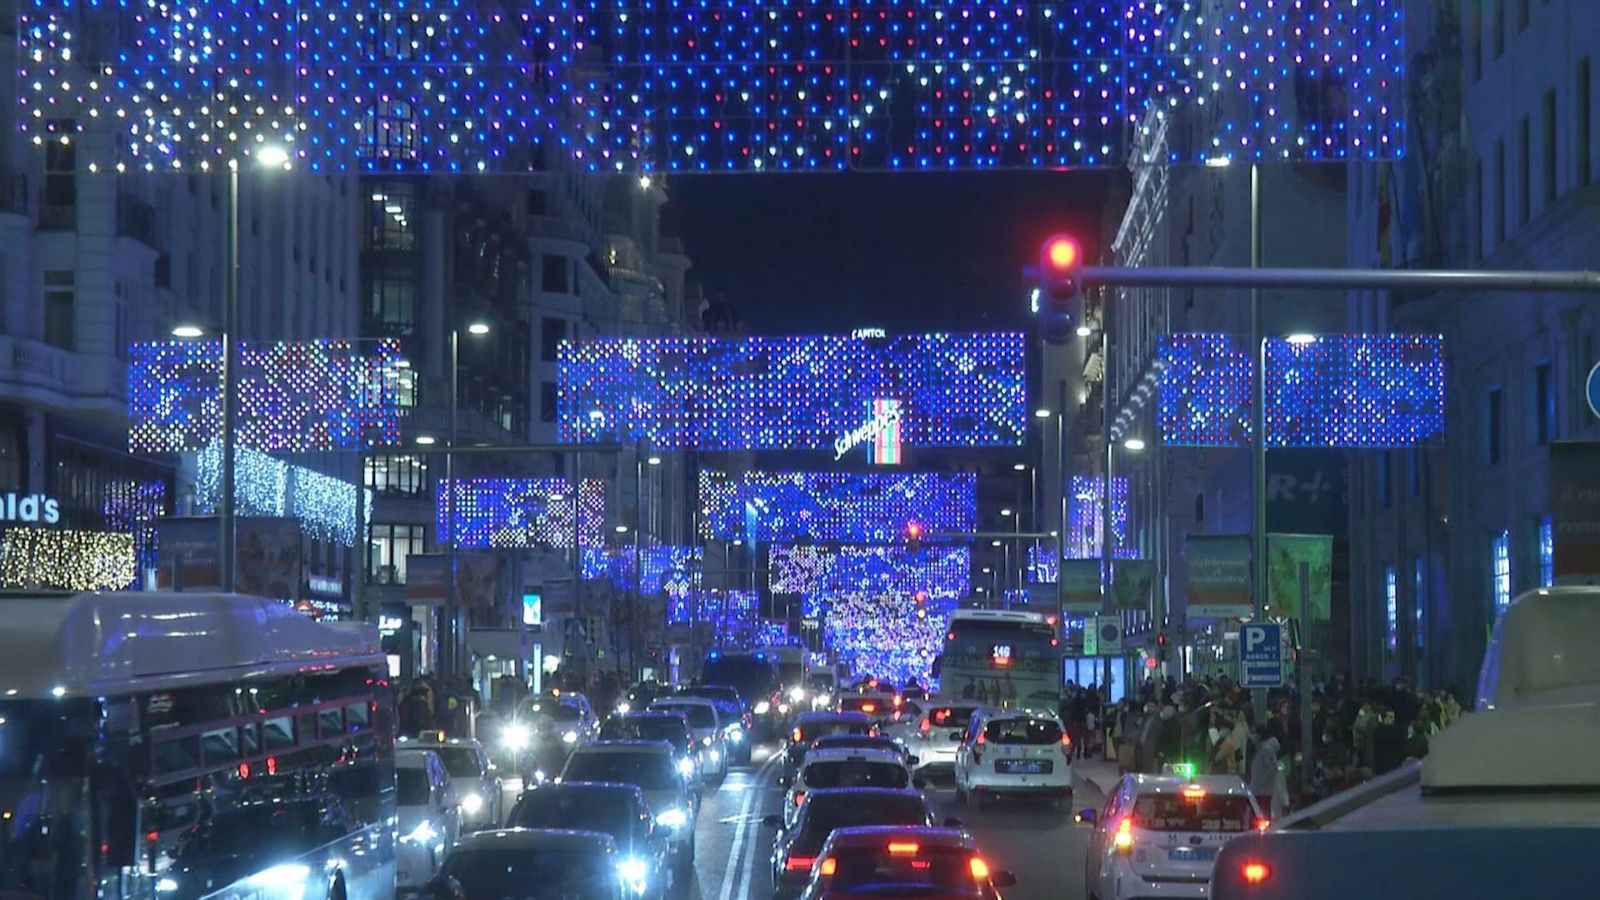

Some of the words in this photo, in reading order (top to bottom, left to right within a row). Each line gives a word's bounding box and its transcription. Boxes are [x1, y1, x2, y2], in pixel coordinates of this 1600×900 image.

[851, 328, 886, 340] CAPITOL
[834, 402, 900, 461] Schweppes
[1246, 627, 1266, 652] P
